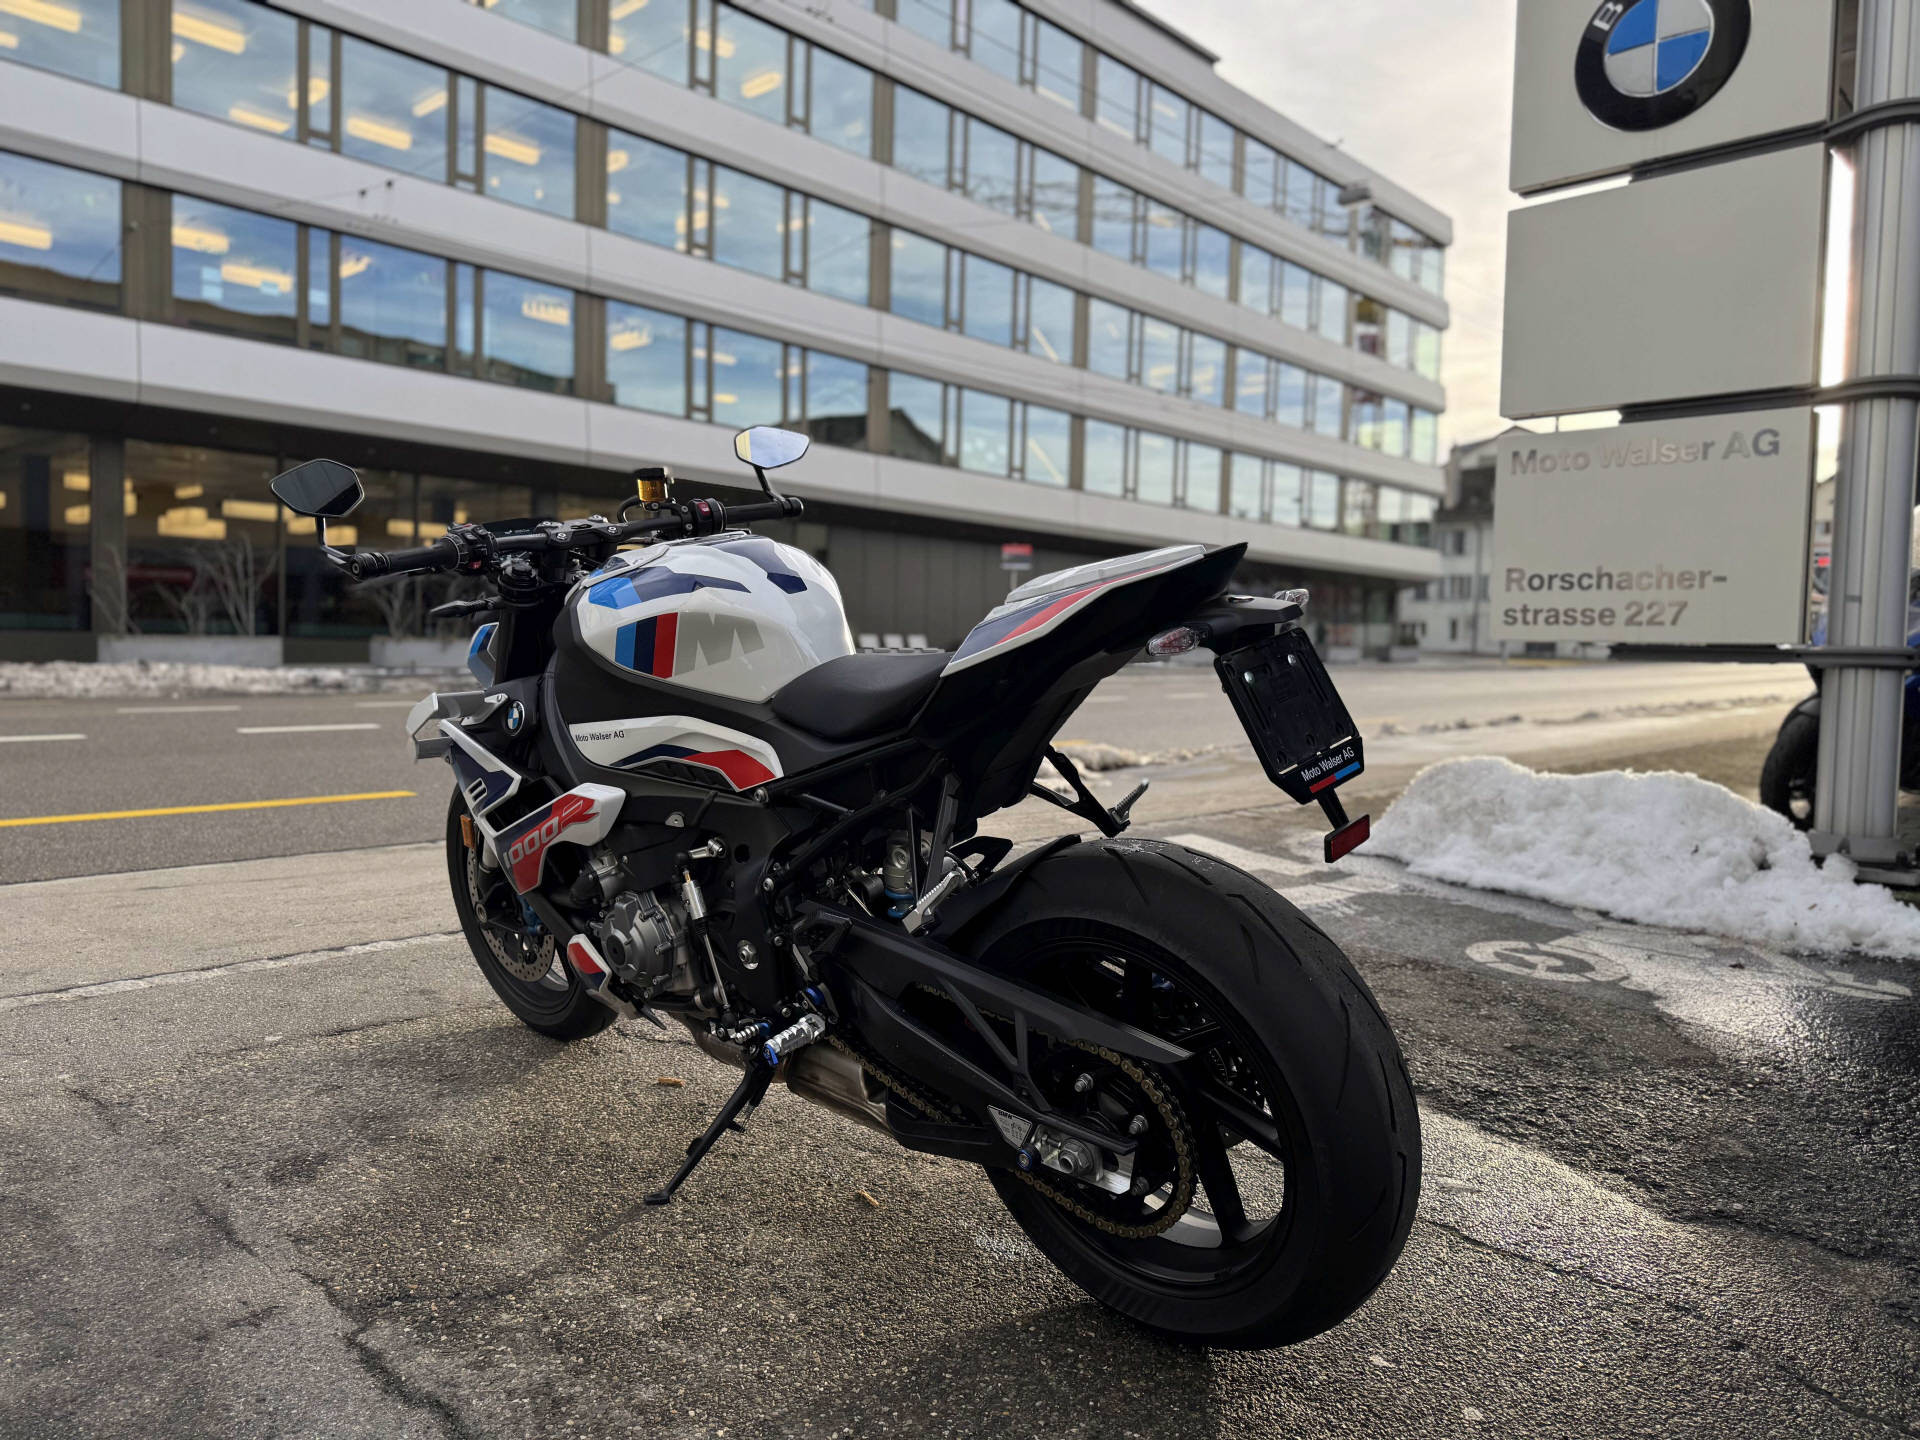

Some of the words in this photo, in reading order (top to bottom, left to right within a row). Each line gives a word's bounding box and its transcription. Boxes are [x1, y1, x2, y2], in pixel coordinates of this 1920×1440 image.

[1511, 448, 1591, 475] Moto
[1600, 437, 1715, 469] Walser
[1721, 428, 1780, 460] AG
[1505, 565, 1728, 592] Rorschacher-
[1502, 603, 1616, 627] strasse
[1623, 601, 1688, 627] 227
[575, 734, 589, 742] Moto
[590, 732, 612, 741] Walser
[613, 730, 625, 739] AG
[1301, 766, 1321, 782] Moto
[1318, 754, 1343, 772] Walser
[1342, 746, 1355, 760] AG
